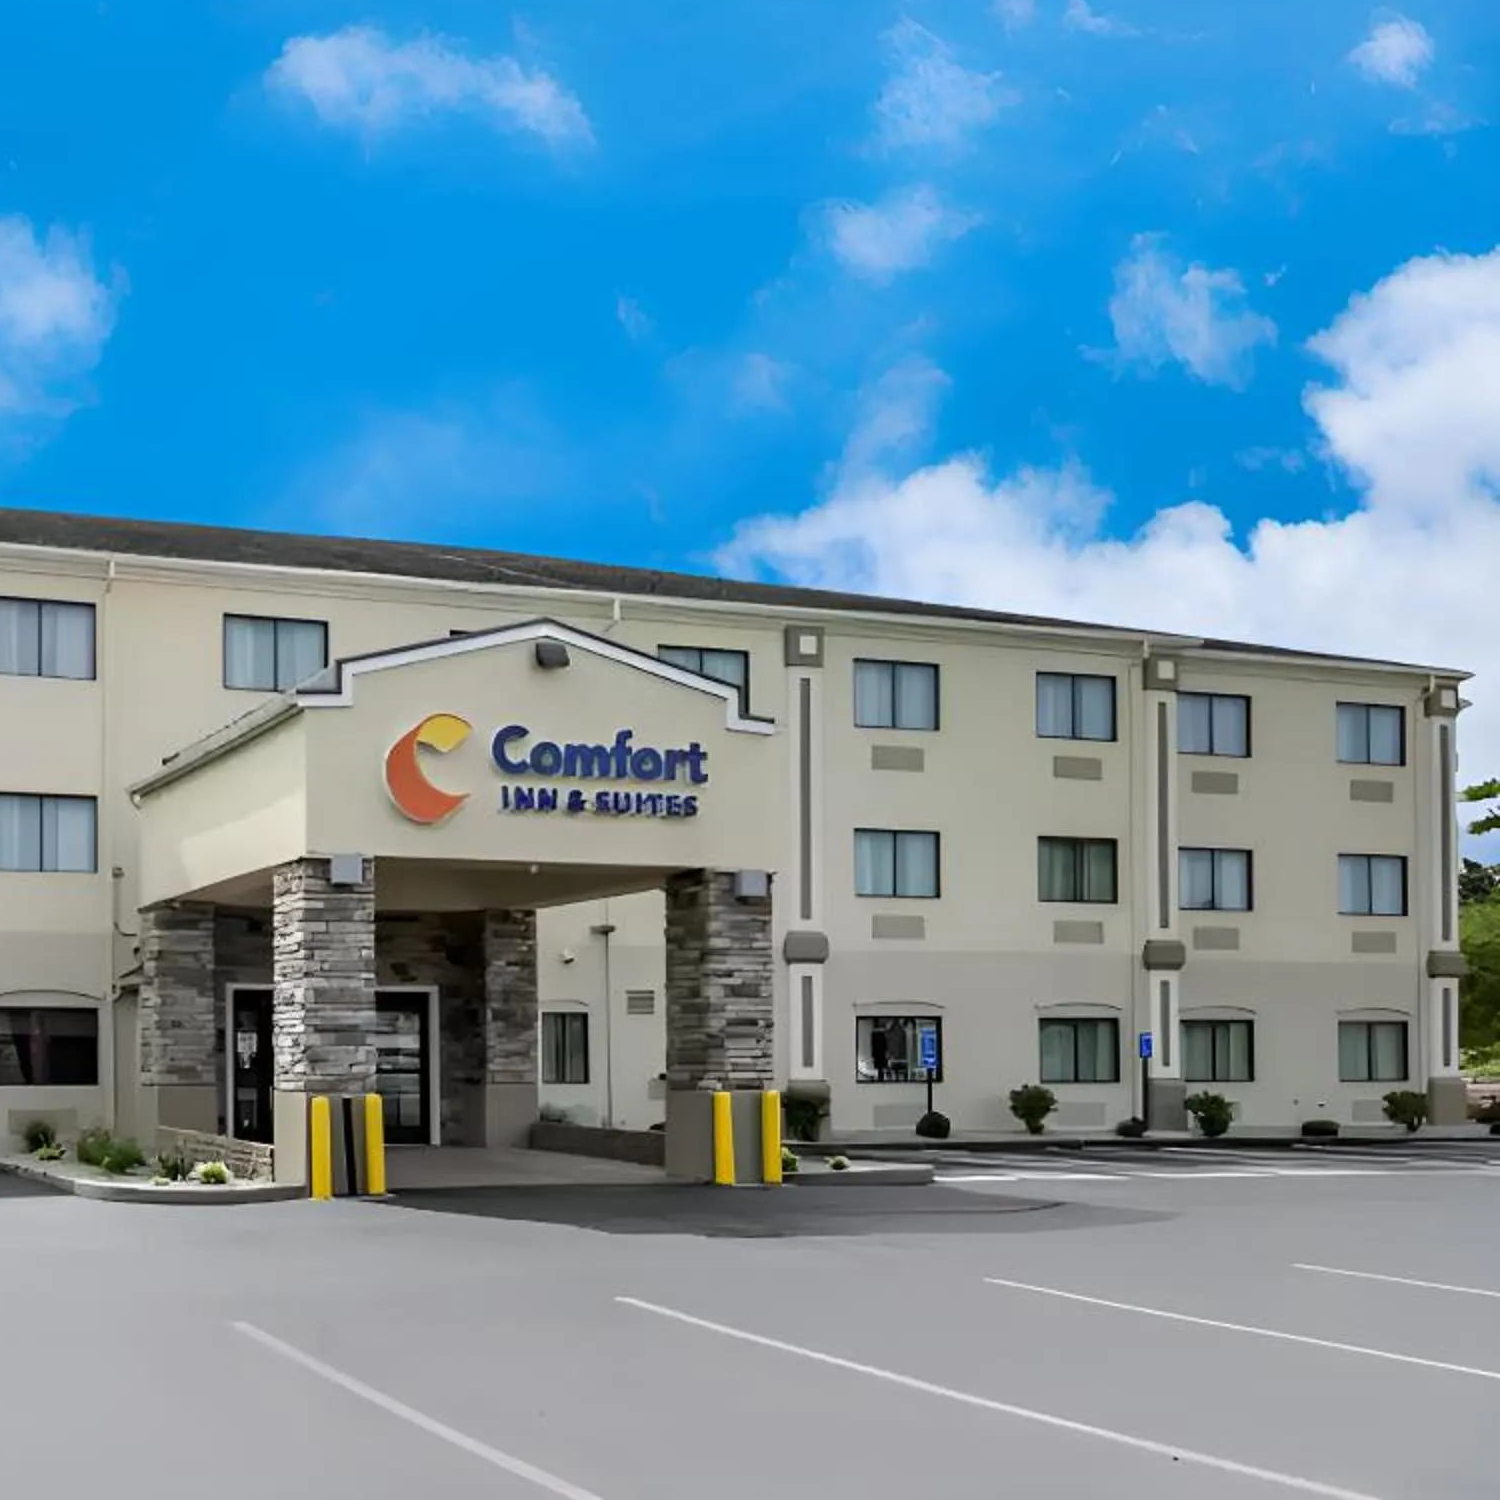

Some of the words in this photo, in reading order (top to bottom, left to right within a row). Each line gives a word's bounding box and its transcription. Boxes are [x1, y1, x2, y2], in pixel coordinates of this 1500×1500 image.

[492, 725, 708, 783] Comfort
[501, 785, 558, 810] INN
[567, 790, 586, 812] &
[595, 792, 698, 817] SUITES
